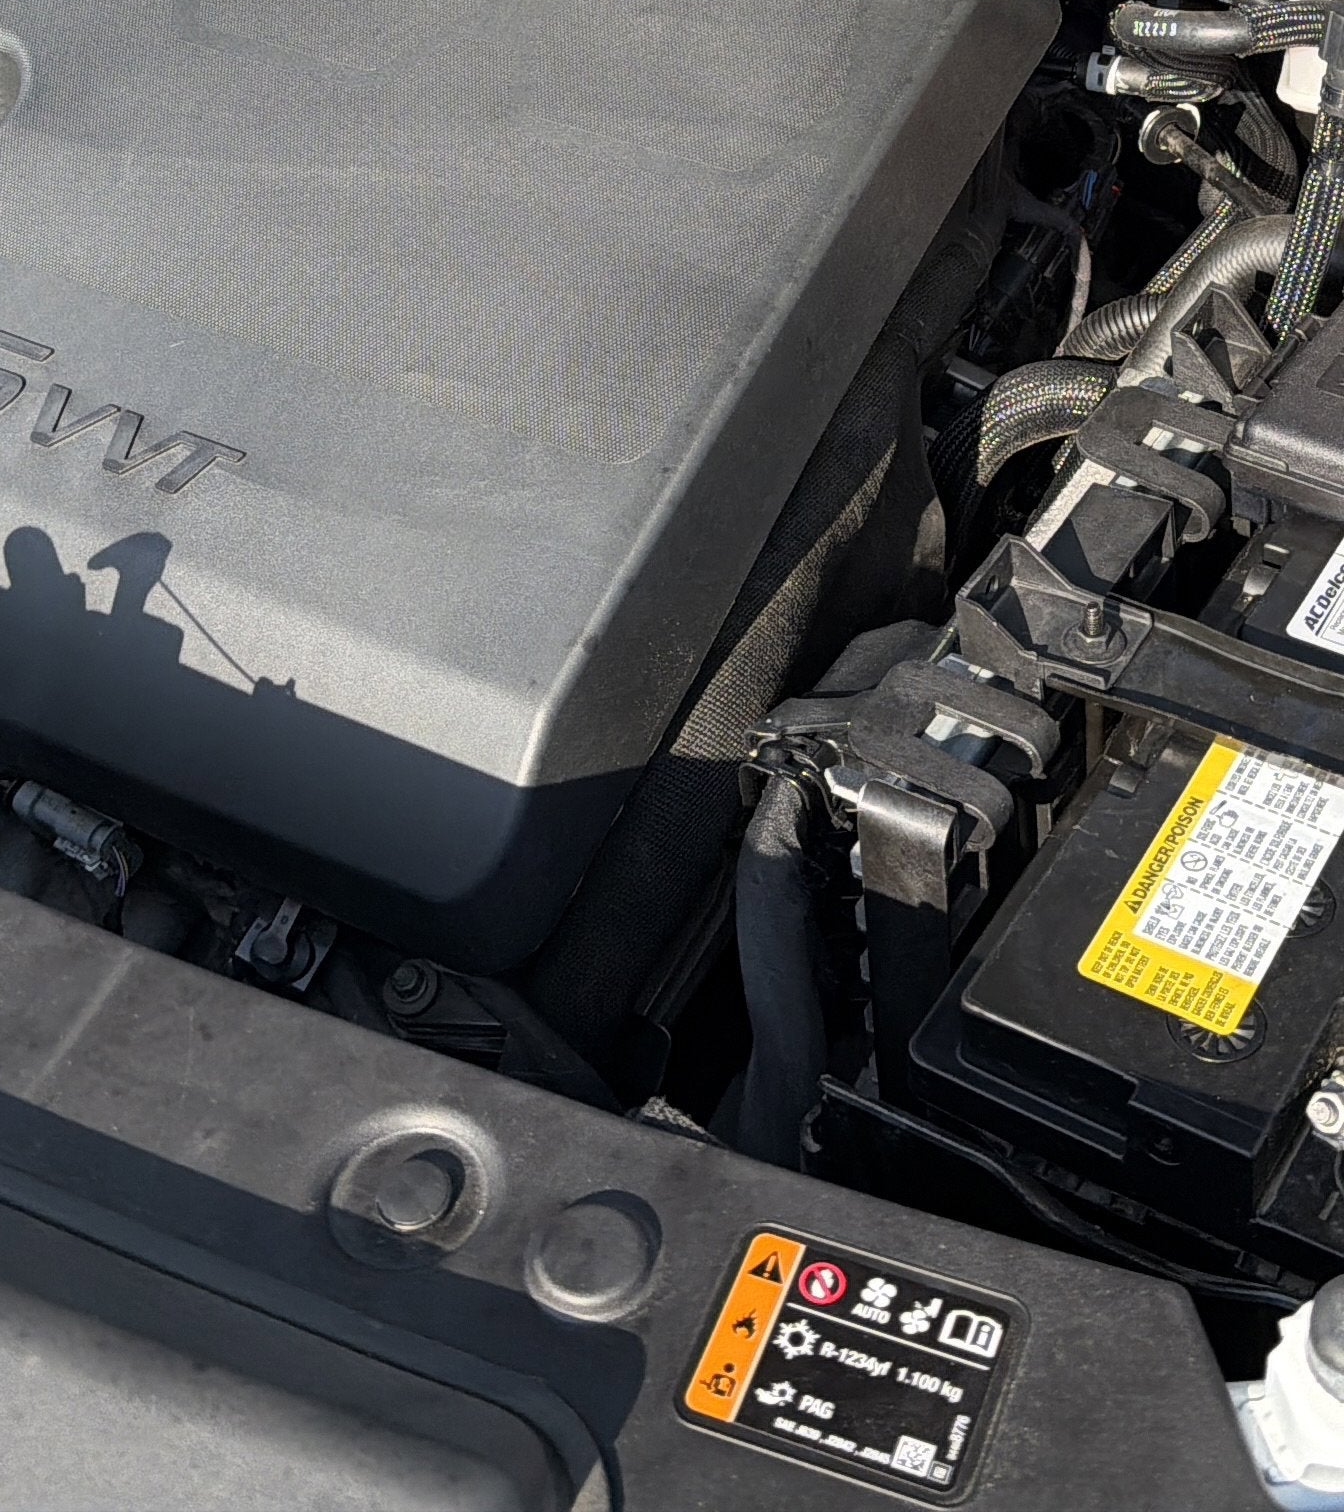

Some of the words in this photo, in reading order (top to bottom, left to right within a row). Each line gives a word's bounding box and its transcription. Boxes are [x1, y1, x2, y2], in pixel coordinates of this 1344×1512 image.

[30, 384, 247, 494] VVT
[1130, 793, 1204, 901] DANGER/POISON
[849, 1301, 892, 1325] AUTO
[815, 1340, 893, 1380] R-1234yf
[892, 1365, 942, 1394] 1.100
[937, 1379, 965, 1404] kg
[795, 1393, 838, 1421] PAG
